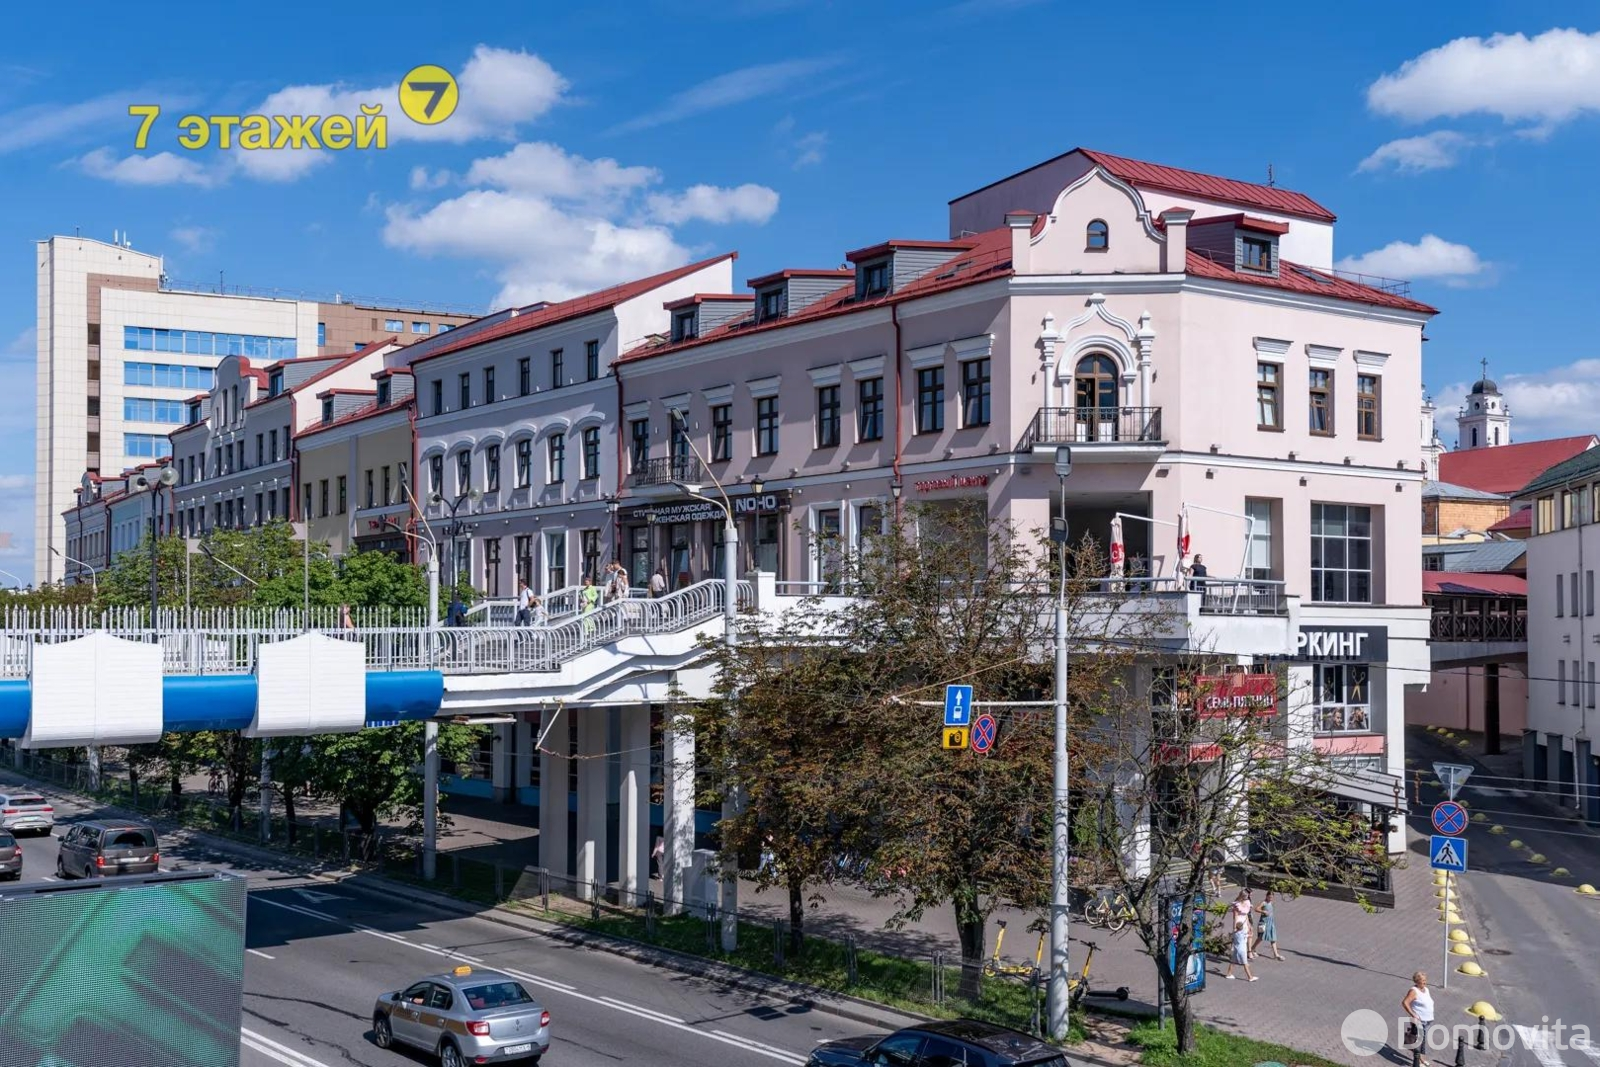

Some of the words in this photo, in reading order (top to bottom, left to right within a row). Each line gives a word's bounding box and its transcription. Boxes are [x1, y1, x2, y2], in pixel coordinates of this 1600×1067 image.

[671, 502, 711, 515] МУЖСКАЯ
[735, 495, 776, 511] NOHO
[654, 514, 690, 524] ЖЕНСКАЯ
[691, 510, 727, 521] ОДЕЖДА
[1296, 631, 1369, 656] РКИНГ
